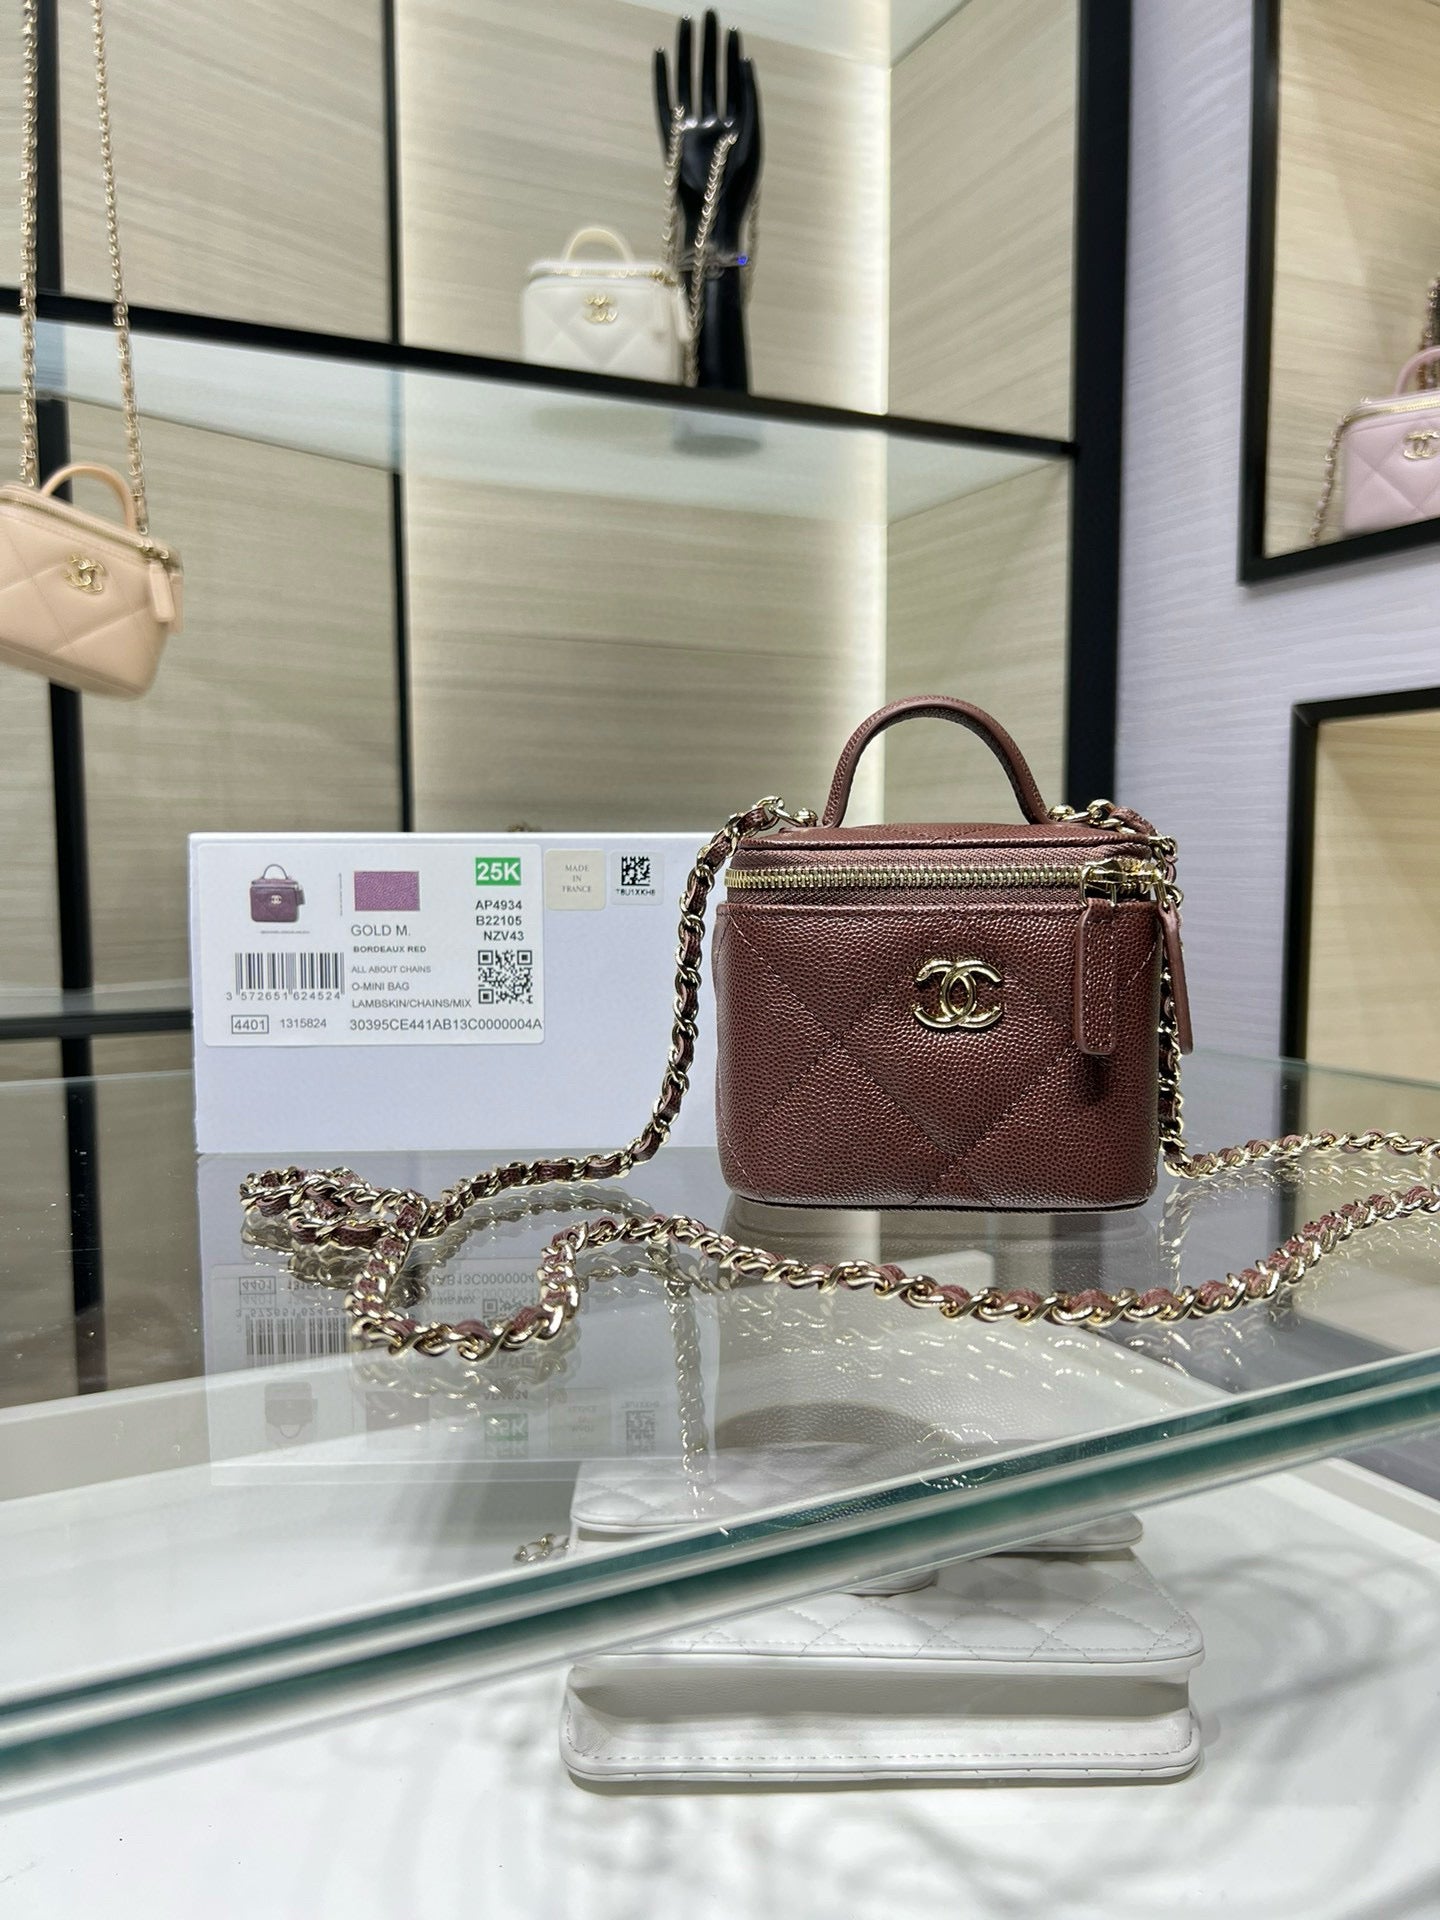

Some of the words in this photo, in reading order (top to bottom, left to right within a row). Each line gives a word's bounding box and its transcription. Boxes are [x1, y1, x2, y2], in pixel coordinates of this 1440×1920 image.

[476, 861, 521, 882] 25K
[565, 864, 590, 873] MADE
[572, 875, 583, 883] IN
[562, 885, 593, 894] FRANCE
[475, 899, 523, 911] AP4934
[476, 915, 523, 927] B22105
[351, 924, 392, 937] GOLD
[395, 924, 411, 937] M.
[483, 930, 525, 942] NZV43
[353, 945, 405, 954] BORDEAUX
[407, 945, 427, 953] RED
[351, 966, 366, 974] ALL
[368, 965, 398, 974] ABOUT
[399, 965, 432, 974] CHAINS
[351, 982, 385, 991] O-MINI
[387, 982, 410, 991] BAG
[226, 991, 233, 1001] 3
[240, 991, 289, 1001] 572651
[293, 991, 341, 1001] 624524
[351, 1000, 472, 1009] LAMBSKIN/CHAINS/MIX
[234, 1019, 266, 1031] 4401
[280, 1018, 327, 1029] 1315824
